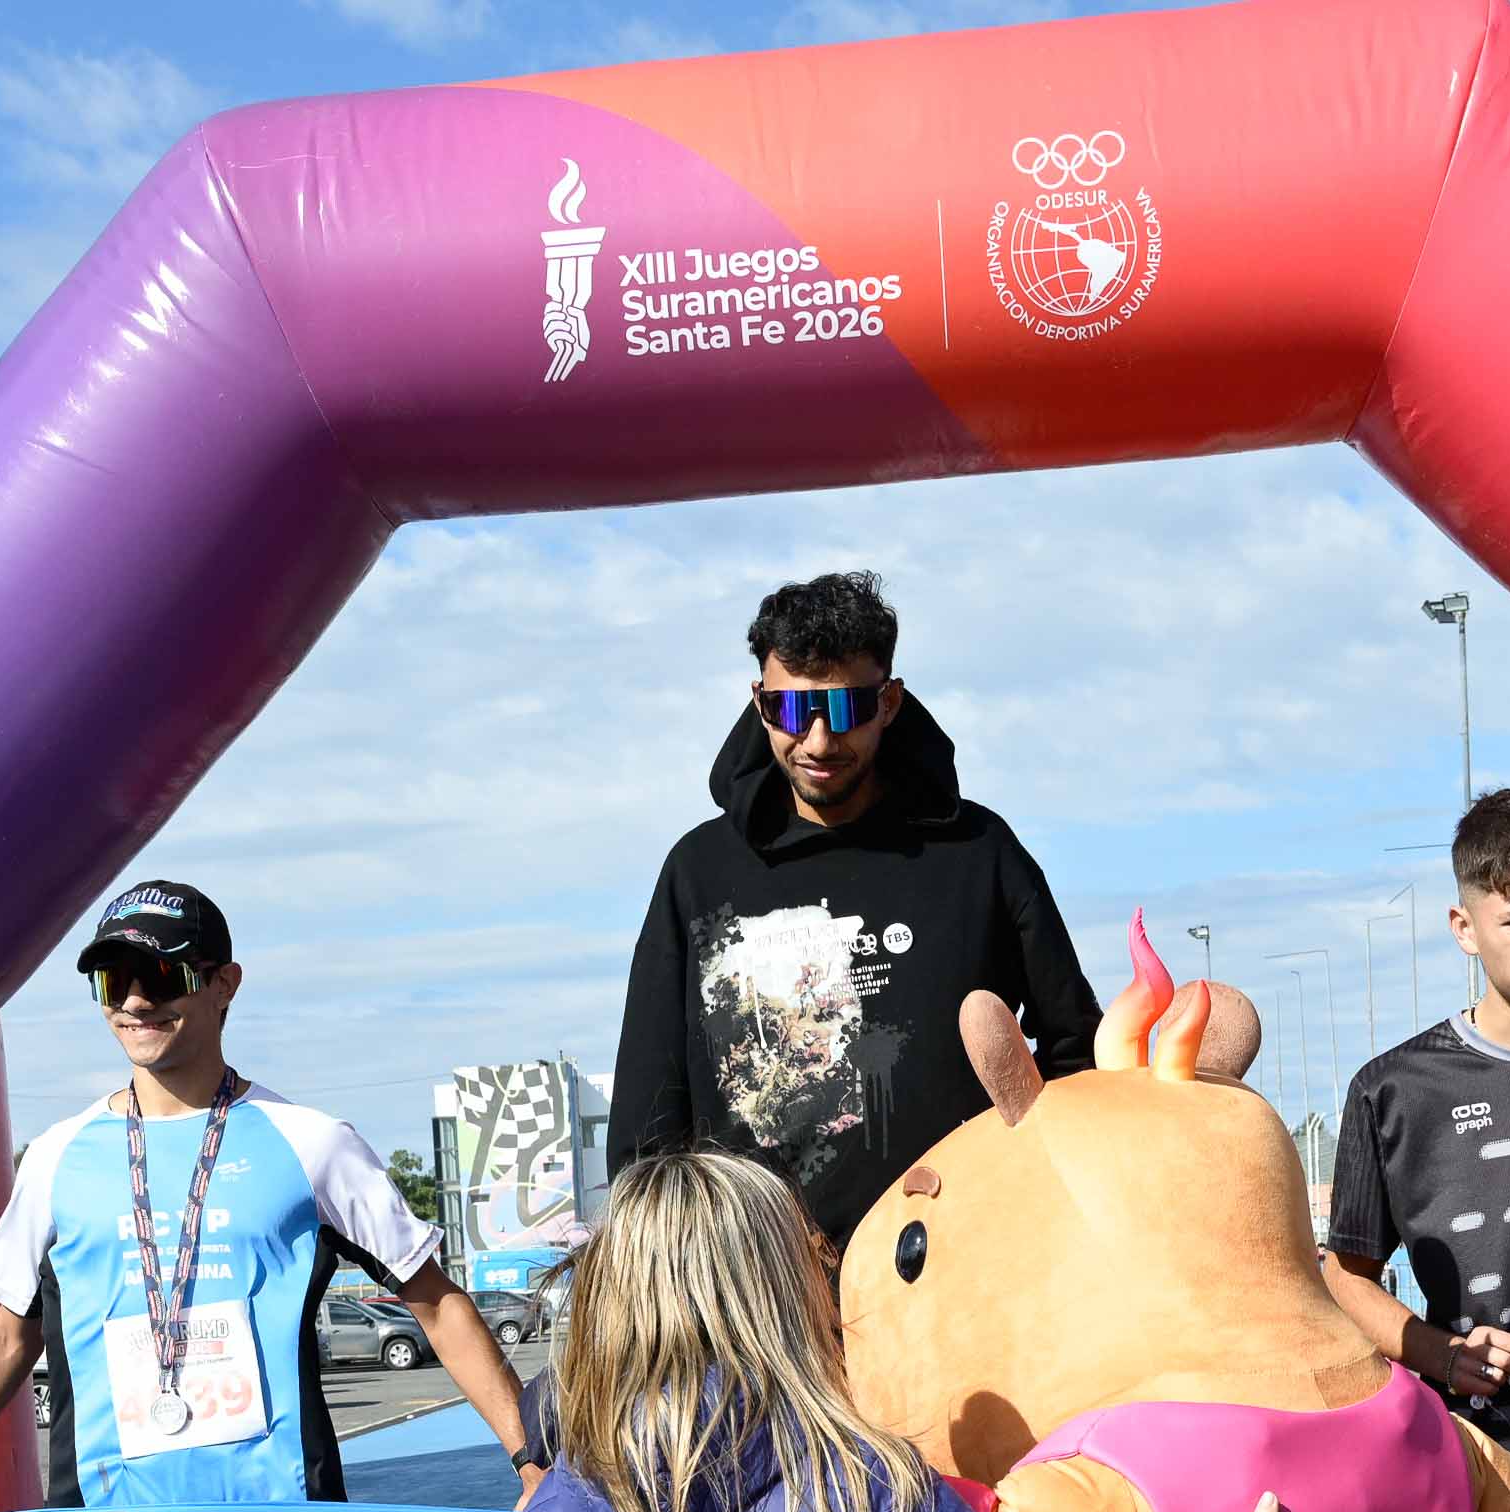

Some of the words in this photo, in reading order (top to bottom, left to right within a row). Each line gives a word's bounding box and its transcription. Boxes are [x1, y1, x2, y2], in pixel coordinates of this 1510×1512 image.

[1035, 190, 1108, 211] ODESUR
[618, 251, 677, 287] XIII
[684, 246, 820, 283] Juegos
[986, 201, 1036, 329] ORGANIZACION
[1034, 314, 1122, 341] DEPORTIVA
[1119, 186, 1163, 320] SURAMERICANA
[621, 274, 903, 322] Suramericanos
[625, 321, 731, 356] Santa
[741, 315, 785, 347] Fe
[793, 305, 885, 342] 2026
[885, 930, 911, 945] TBS
[1454, 1116, 1493, 1135] graph
